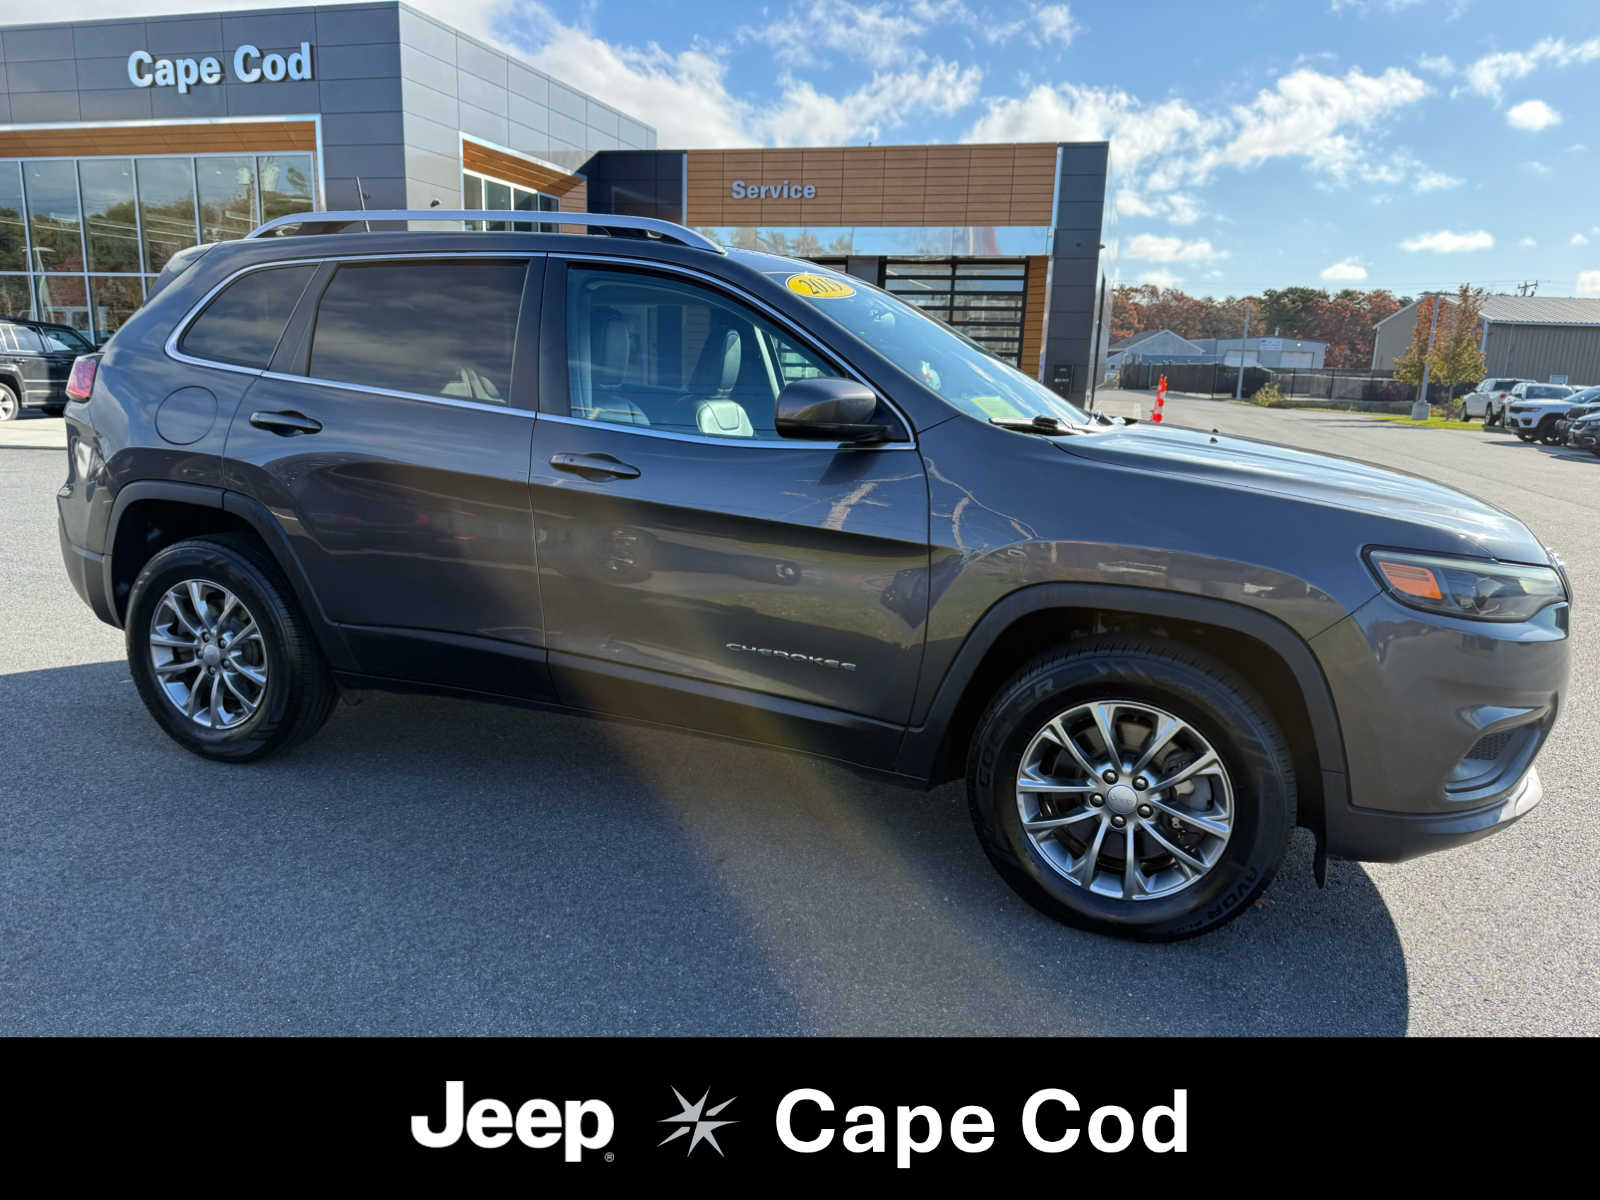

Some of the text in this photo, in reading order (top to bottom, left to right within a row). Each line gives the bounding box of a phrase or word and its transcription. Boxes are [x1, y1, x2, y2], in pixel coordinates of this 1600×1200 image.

[127, 42, 314, 94] Cape Cod
[731, 180, 816, 199] Service
[726, 643, 857, 671] CHEROKEE
